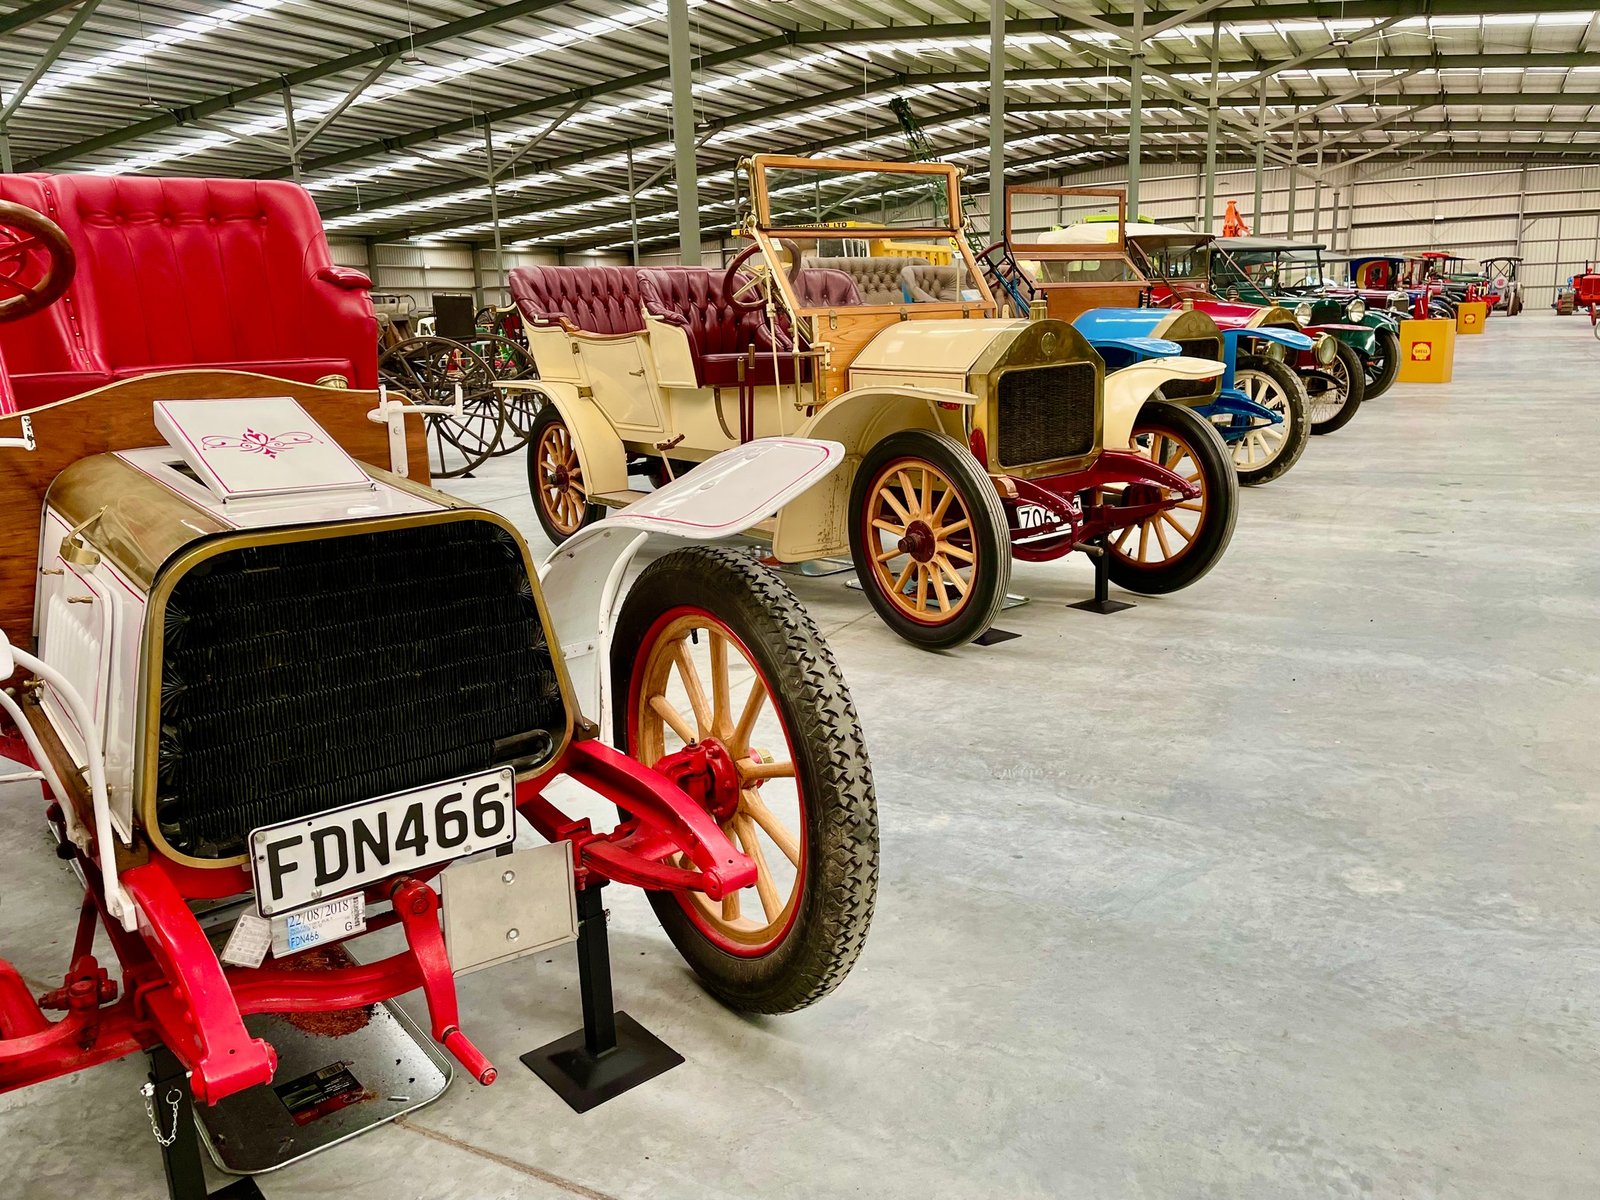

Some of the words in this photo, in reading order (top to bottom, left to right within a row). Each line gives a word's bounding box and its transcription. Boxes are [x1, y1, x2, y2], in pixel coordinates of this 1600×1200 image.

[266, 783, 505, 900] FDN466
[288, 900, 350, 928] 22/08/2018
[344, 921, 353, 932] G
[290, 932, 320, 948] FDN466
